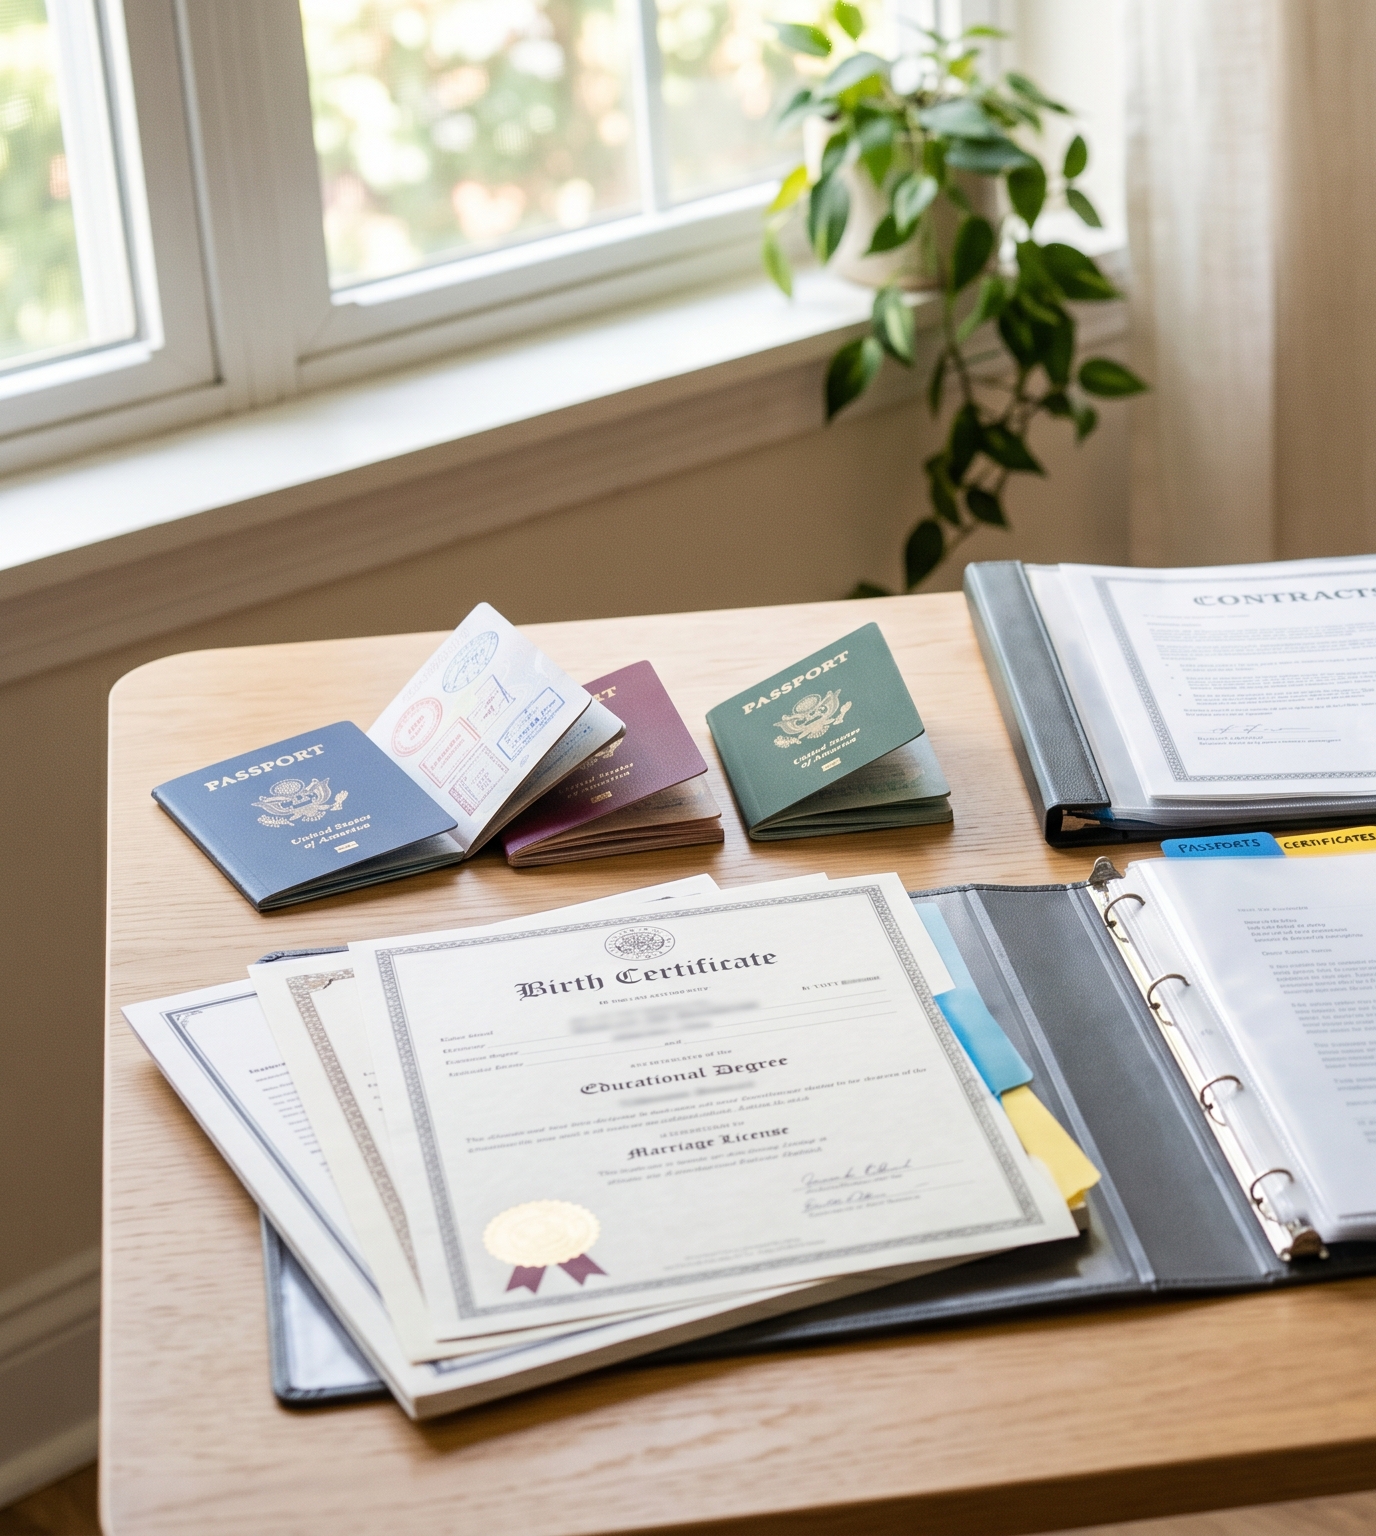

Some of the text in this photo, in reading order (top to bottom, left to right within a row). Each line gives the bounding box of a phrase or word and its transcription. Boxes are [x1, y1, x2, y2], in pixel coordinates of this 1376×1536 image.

[742, 650, 849, 715] PASSPORT
[204, 744, 325, 792] PASSPORT
[1283, 832, 1376, 850] CERTIFICATES
[514, 973, 605, 1001] Birth
[615, 951, 778, 985] Certificate
[580, 1057, 789, 1095] Educational Degree
[626, 1126, 790, 1161] Marriage License
